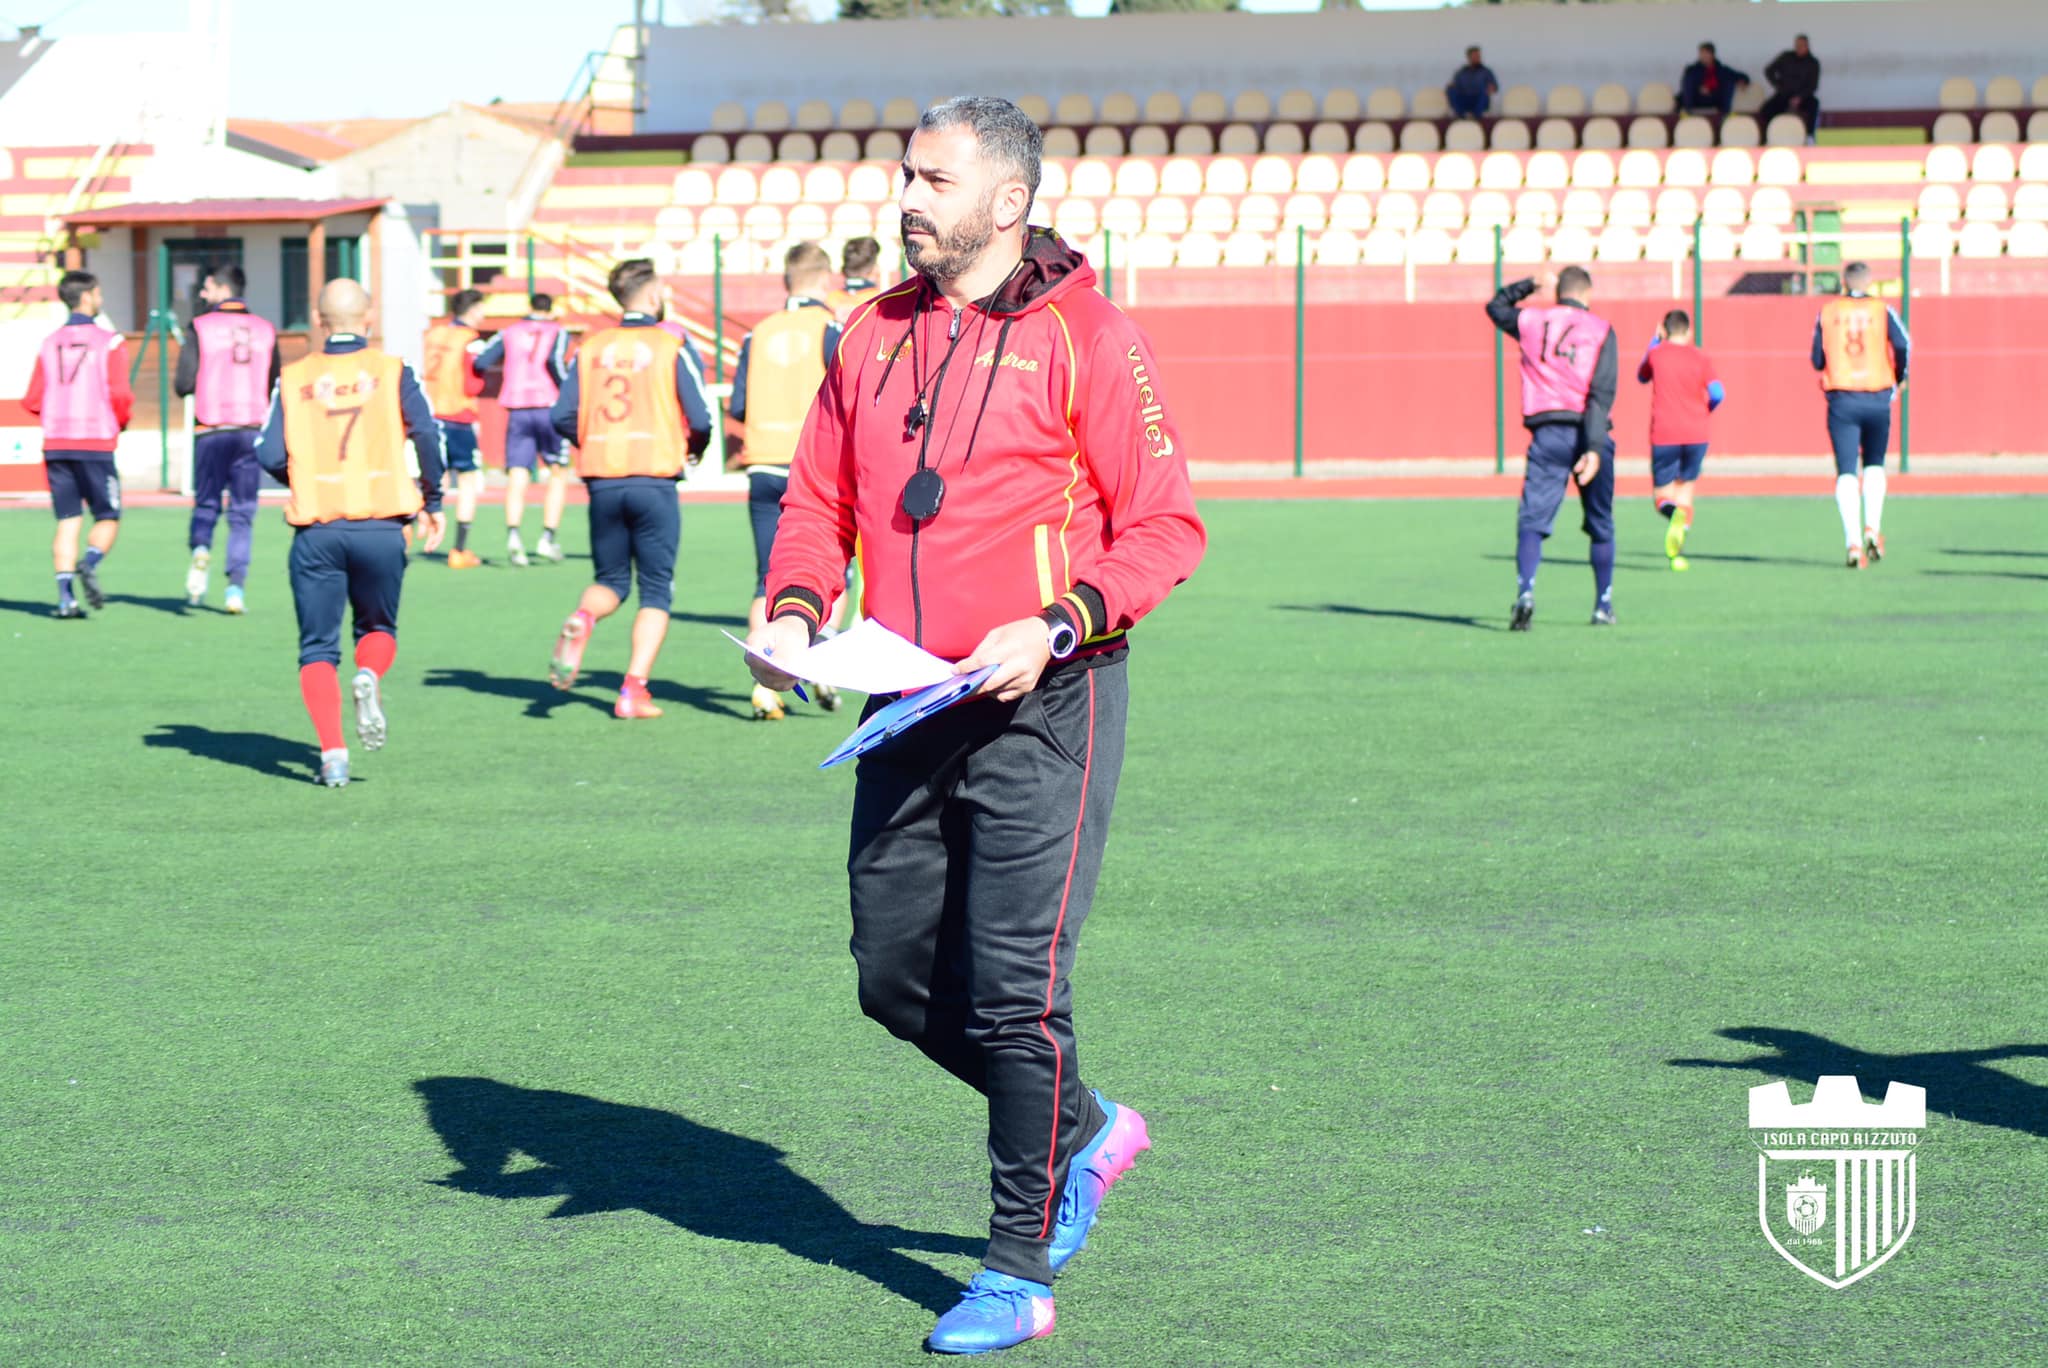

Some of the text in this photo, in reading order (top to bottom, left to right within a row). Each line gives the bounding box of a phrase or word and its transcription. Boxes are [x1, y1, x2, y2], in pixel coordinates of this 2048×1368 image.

[57, 344, 90, 384] 17
[1540, 320, 1576, 365] 14
[601, 374, 632, 424] 3
[1127, 344, 1174, 459] vuelle3
[324, 405, 363, 462] 7
